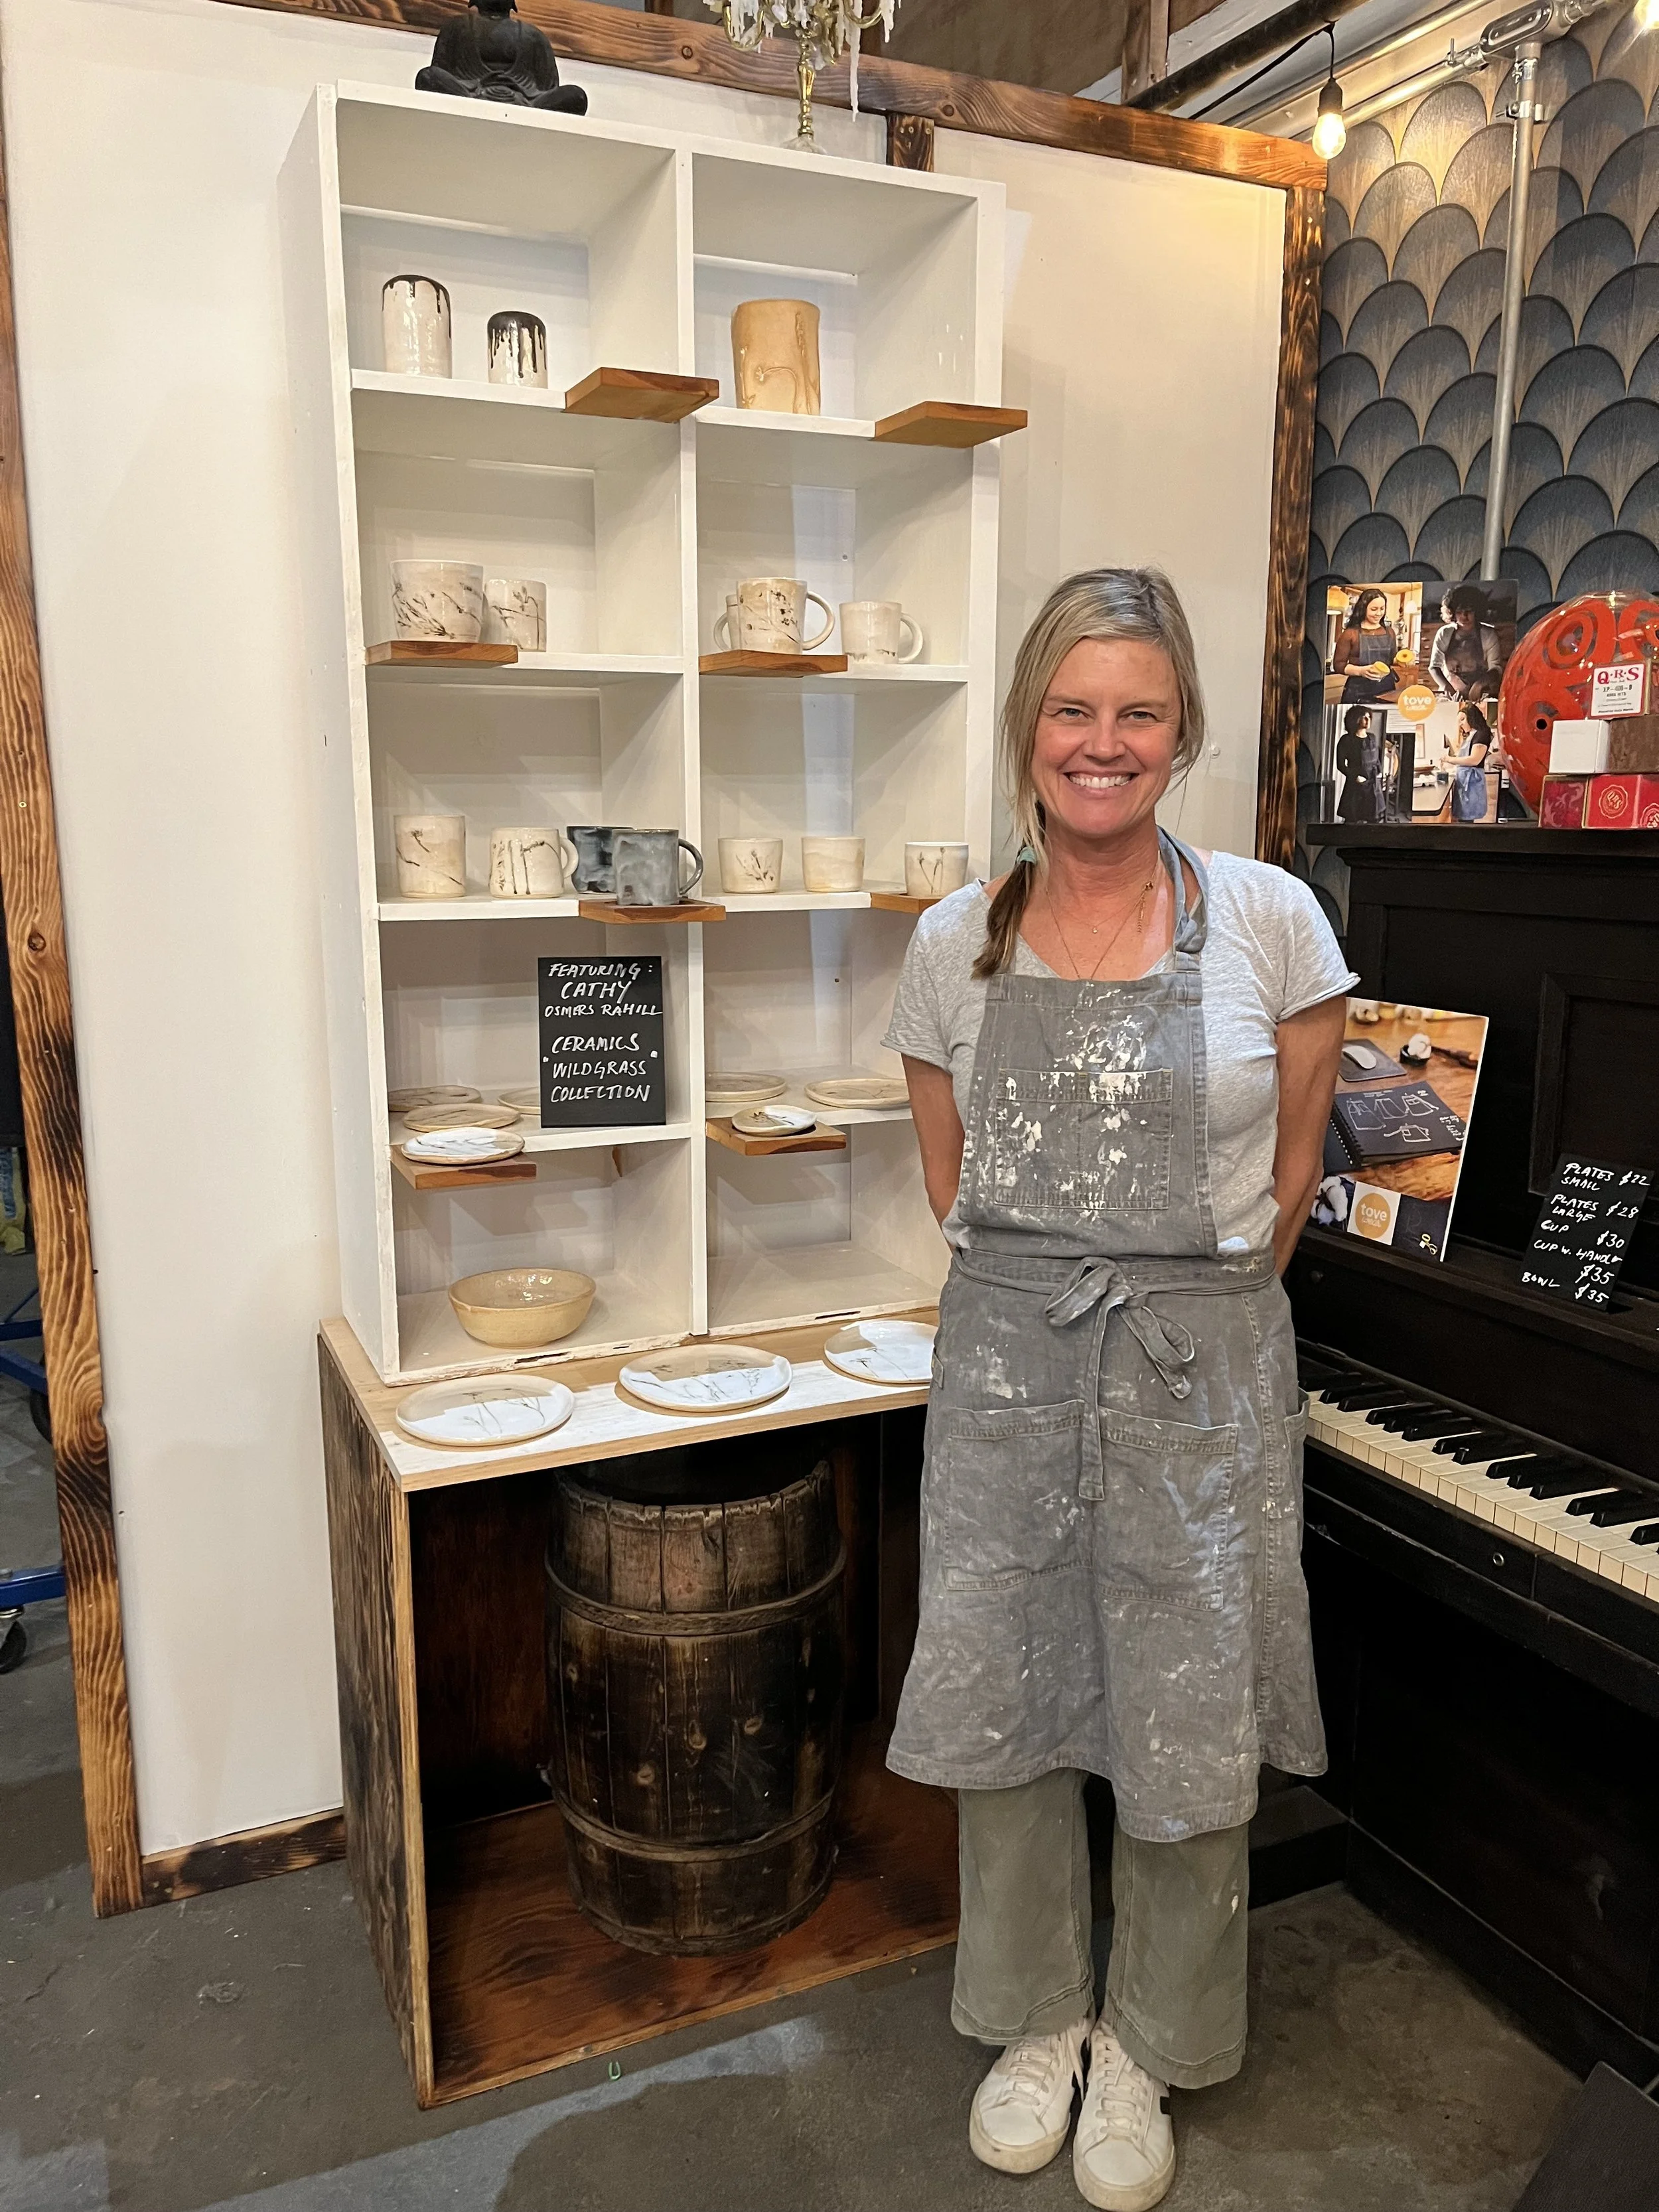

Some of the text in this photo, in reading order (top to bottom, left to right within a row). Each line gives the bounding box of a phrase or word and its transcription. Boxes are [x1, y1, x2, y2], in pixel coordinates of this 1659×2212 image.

[1403, 695, 1431, 705] tove
[561, 981, 632, 1003] CATHY
[545, 1003, 663, 1017] OSMERS RAHILL
[551, 1033, 640, 1054] CERAMICS
[551, 1084, 650, 1102] COLLECTION
[1561, 1176, 1601, 1191] SMALL
[1563, 1163, 1650, 1185] PLATES $22
[1360, 1203, 1387, 1221] tove
[1550, 1194, 1639, 1218] PLATES $28
[1552, 1206, 1596, 1223] LARGE
[1540, 1219, 1624, 1248] CUP $30
[1534, 1239, 1558, 1252] CUP
[1576, 1248, 1623, 1264] HANDLE
[1575, 1264, 1615, 1284] $35
[1522, 1272, 1609, 1303] BOWL $35
